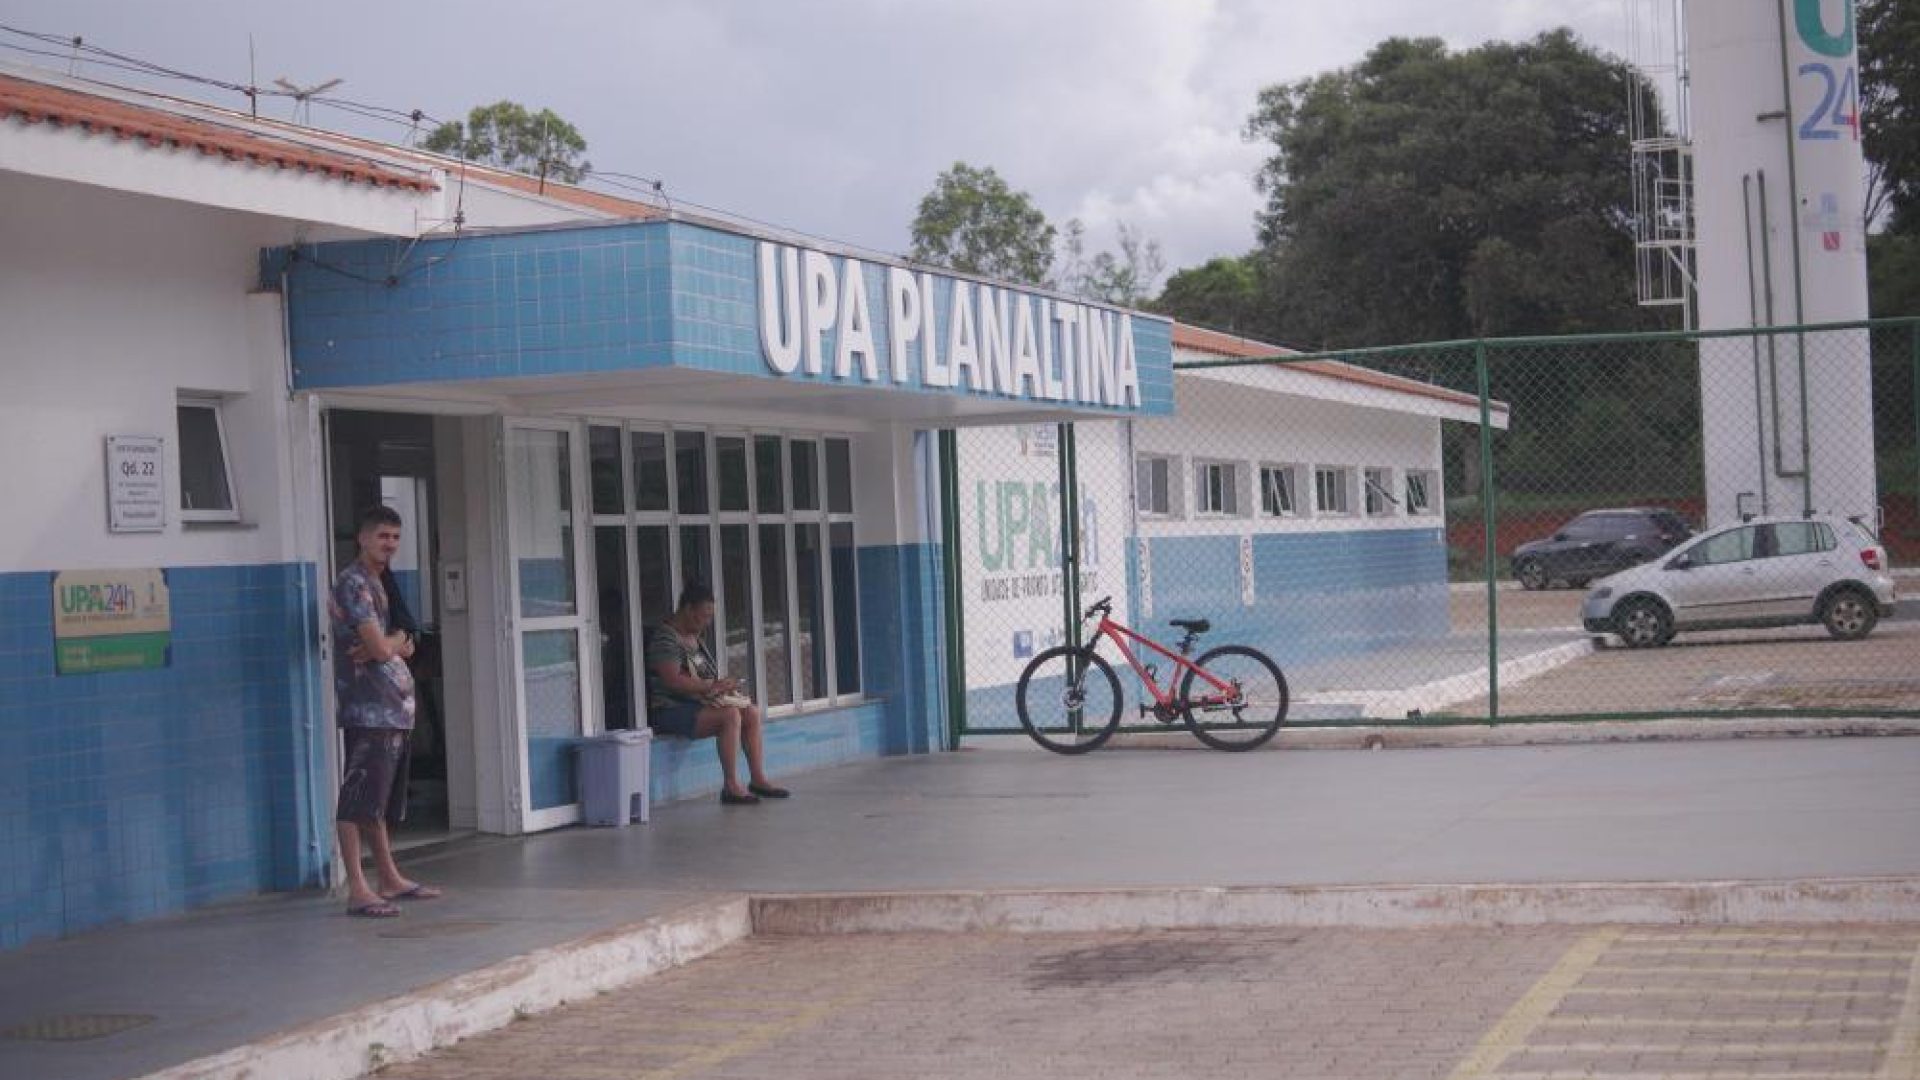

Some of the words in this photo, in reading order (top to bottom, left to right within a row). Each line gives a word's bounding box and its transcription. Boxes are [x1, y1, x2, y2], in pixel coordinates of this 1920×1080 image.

[757, 242, 878, 381] UPA
[889, 267, 1141, 407] PLANALTINA
[142, 461, 154, 476] 22
[60, 584, 135, 613] UPA24h
